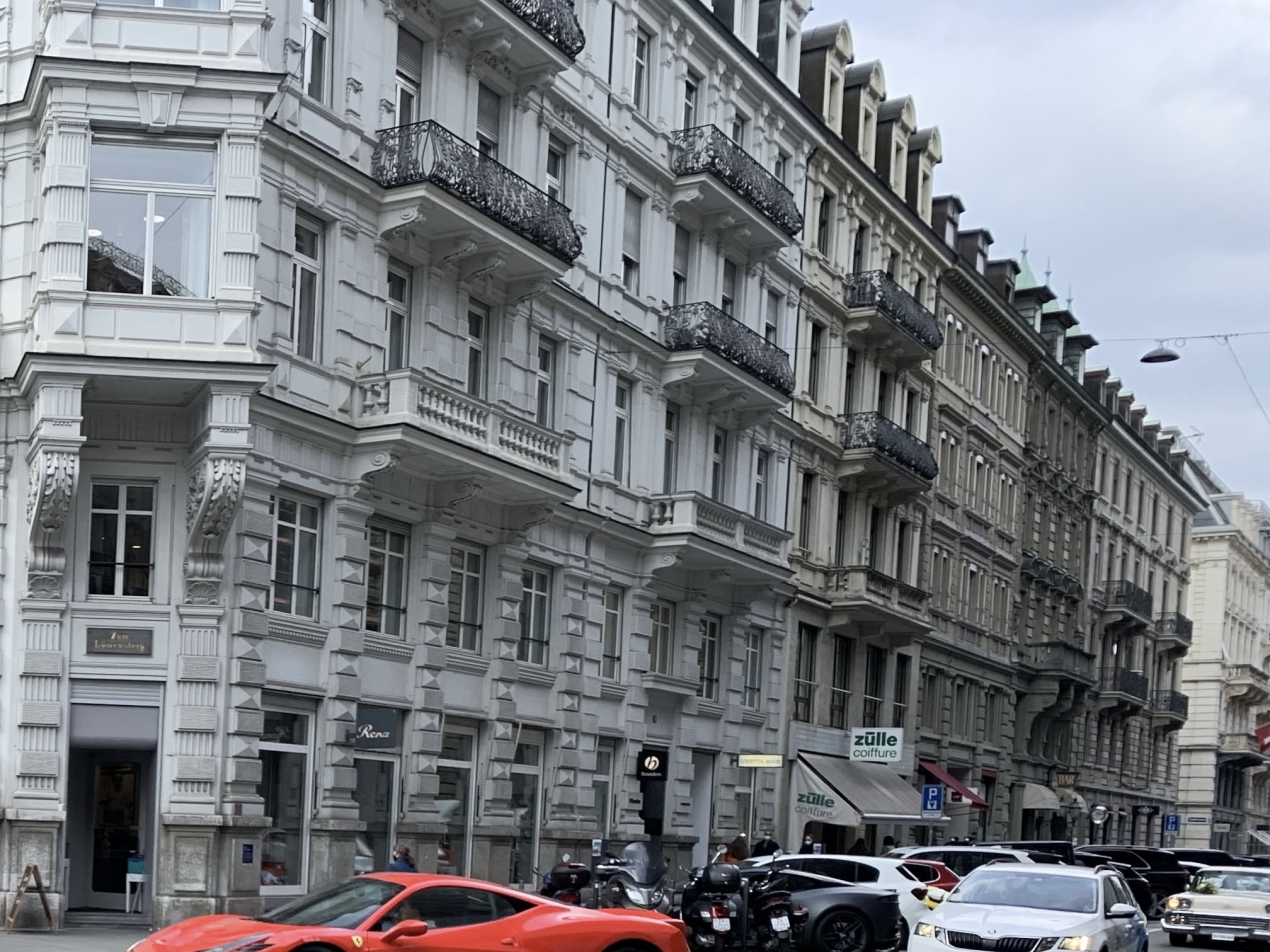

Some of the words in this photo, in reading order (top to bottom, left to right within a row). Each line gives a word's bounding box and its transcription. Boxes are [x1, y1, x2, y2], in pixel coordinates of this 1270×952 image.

[356, 723, 390, 739] Rena
[853, 747, 897, 759] coiffure
[1059, 775, 1075, 785] BAR
[929, 787, 938, 800] P
[795, 805, 833, 819] coiffure
